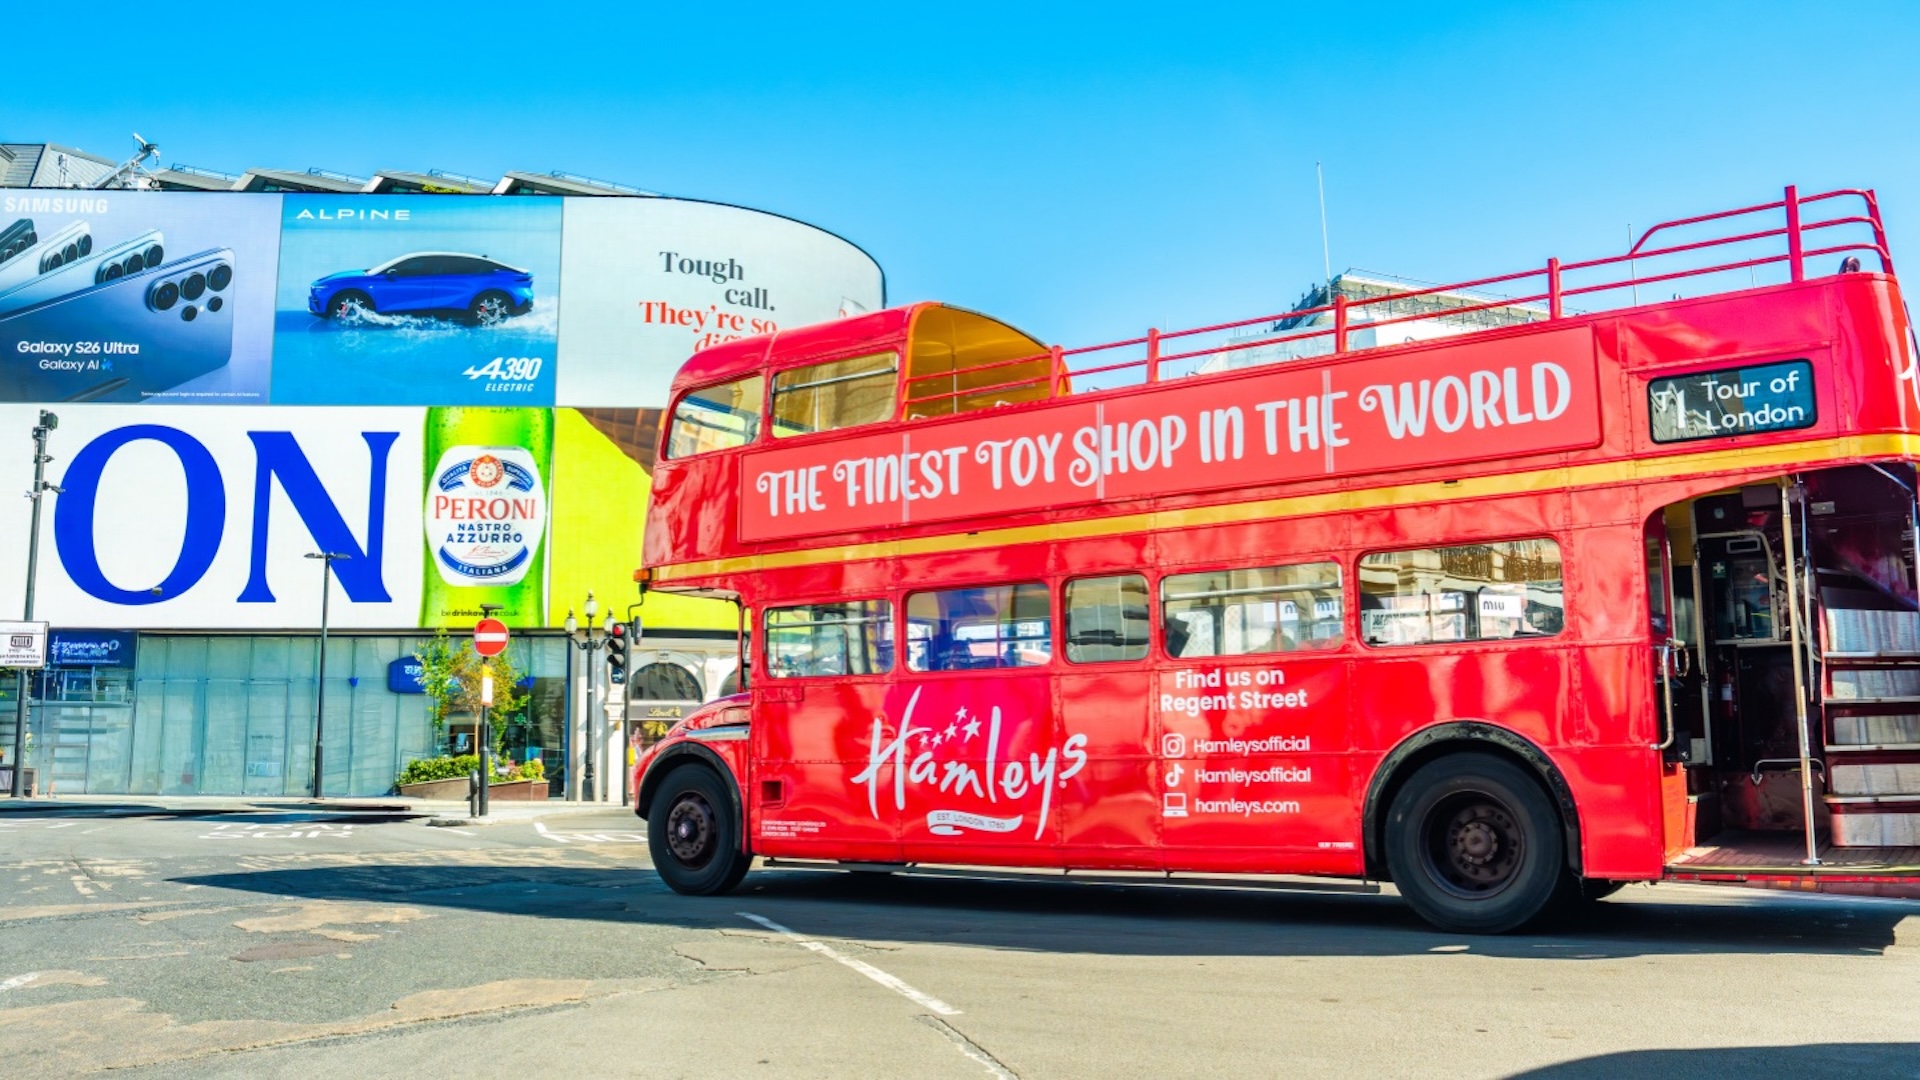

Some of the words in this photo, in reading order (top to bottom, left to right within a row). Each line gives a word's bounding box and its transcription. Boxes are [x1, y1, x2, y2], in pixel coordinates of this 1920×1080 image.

[4, 196, 109, 213] SAMSUNG
[296, 208, 411, 220] ALPINE
[659, 252, 744, 284] Tough
[724, 287, 776, 311] call.
[639, 301, 744, 333] They're
[750, 317, 777, 333] so
[17, 341, 73, 356] Galaxy
[75, 342, 101, 354] S26
[103, 342, 140, 355] Ultra
[39, 359, 84, 372] Galaxy
[86, 359, 99, 371] AI
[462, 357, 543, 380] A390
[485, 383, 535, 392] ELECTRIC
[1702, 381, 1760, 402] Tour
[1769, 370, 1800, 393] of
[1706, 403, 1805, 431] London
[757, 465, 826, 516] THE
[833, 446, 968, 507] FINEST
[975, 433, 1063, 490] TOY
[1068, 414, 1187, 487] SHOP
[1199, 406, 1244, 463] IN
[1255, 391, 1350, 456] THE
[1358, 361, 1571, 440] WORLD
[54, 423, 400, 605] ON
[435, 495, 536, 520] PERONI
[458, 523, 512, 531] NASTRO
[446, 533, 523, 543] AZZURRO
[458, 564, 508, 576] ITALIANA
[1175, 669, 1221, 688] Find
[1225, 670, 1251, 686] us
[1256, 669, 1285, 685] on
[1160, 694, 1236, 717] Regent
[1240, 689, 1308, 709] Street
[1193, 736, 1310, 756] Hamleysofficial
[851, 685, 1088, 840] Hamleys
[1194, 767, 1311, 787] Hamleysofficial
[1195, 798, 1300, 817] hamleys.com
